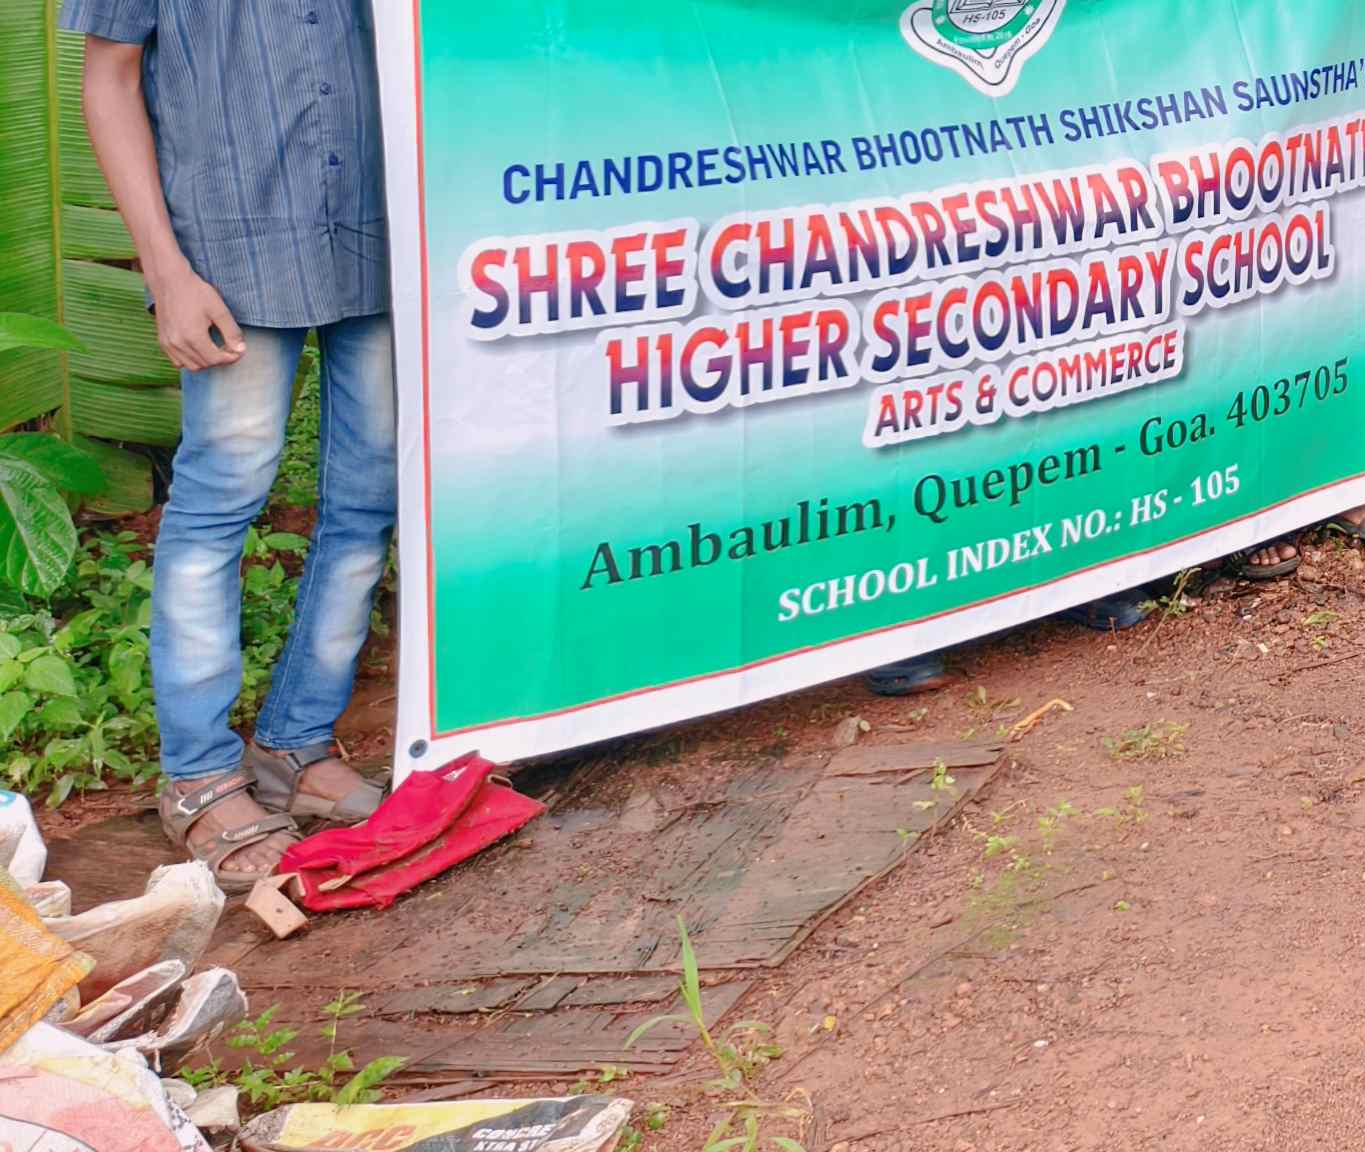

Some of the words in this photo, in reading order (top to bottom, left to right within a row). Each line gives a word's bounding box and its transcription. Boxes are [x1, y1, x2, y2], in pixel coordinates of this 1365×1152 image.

[962, 9, 1006, 24] HS-105
[503, 139, 847, 204] CHANDRESHWAR
[852, 114, 1052, 170] BHOOTNATH
[1059, 90, 1227, 142] SHIKSHAN
[470, 228, 687, 329] SHREE
[710, 167, 1155, 298] CHANDRESHWAR
[606, 309, 848, 414] HIGHER
[871, 248, 1169, 372] SECONDARY
[1183, 210, 1330, 306] SCHOOL
[874, 380, 962, 436] ARTS
[976, 374, 996, 414] &
[1008, 329, 1177, 407] COMMERCE
[580, 497, 895, 590] Ambaulim,
[914, 442, 1102, 523] Quepem
[1139, 412, 1215, 456] Goa.
[1226, 356, 1349, 429] 403705
[778, 557, 937, 621] SCHOOL
[947, 526, 1053, 581] INDEX
[1060, 509, 1122, 547] NO.:
[1129, 488, 1168, 528] HS
[1191, 464, 1240, 507] 105
